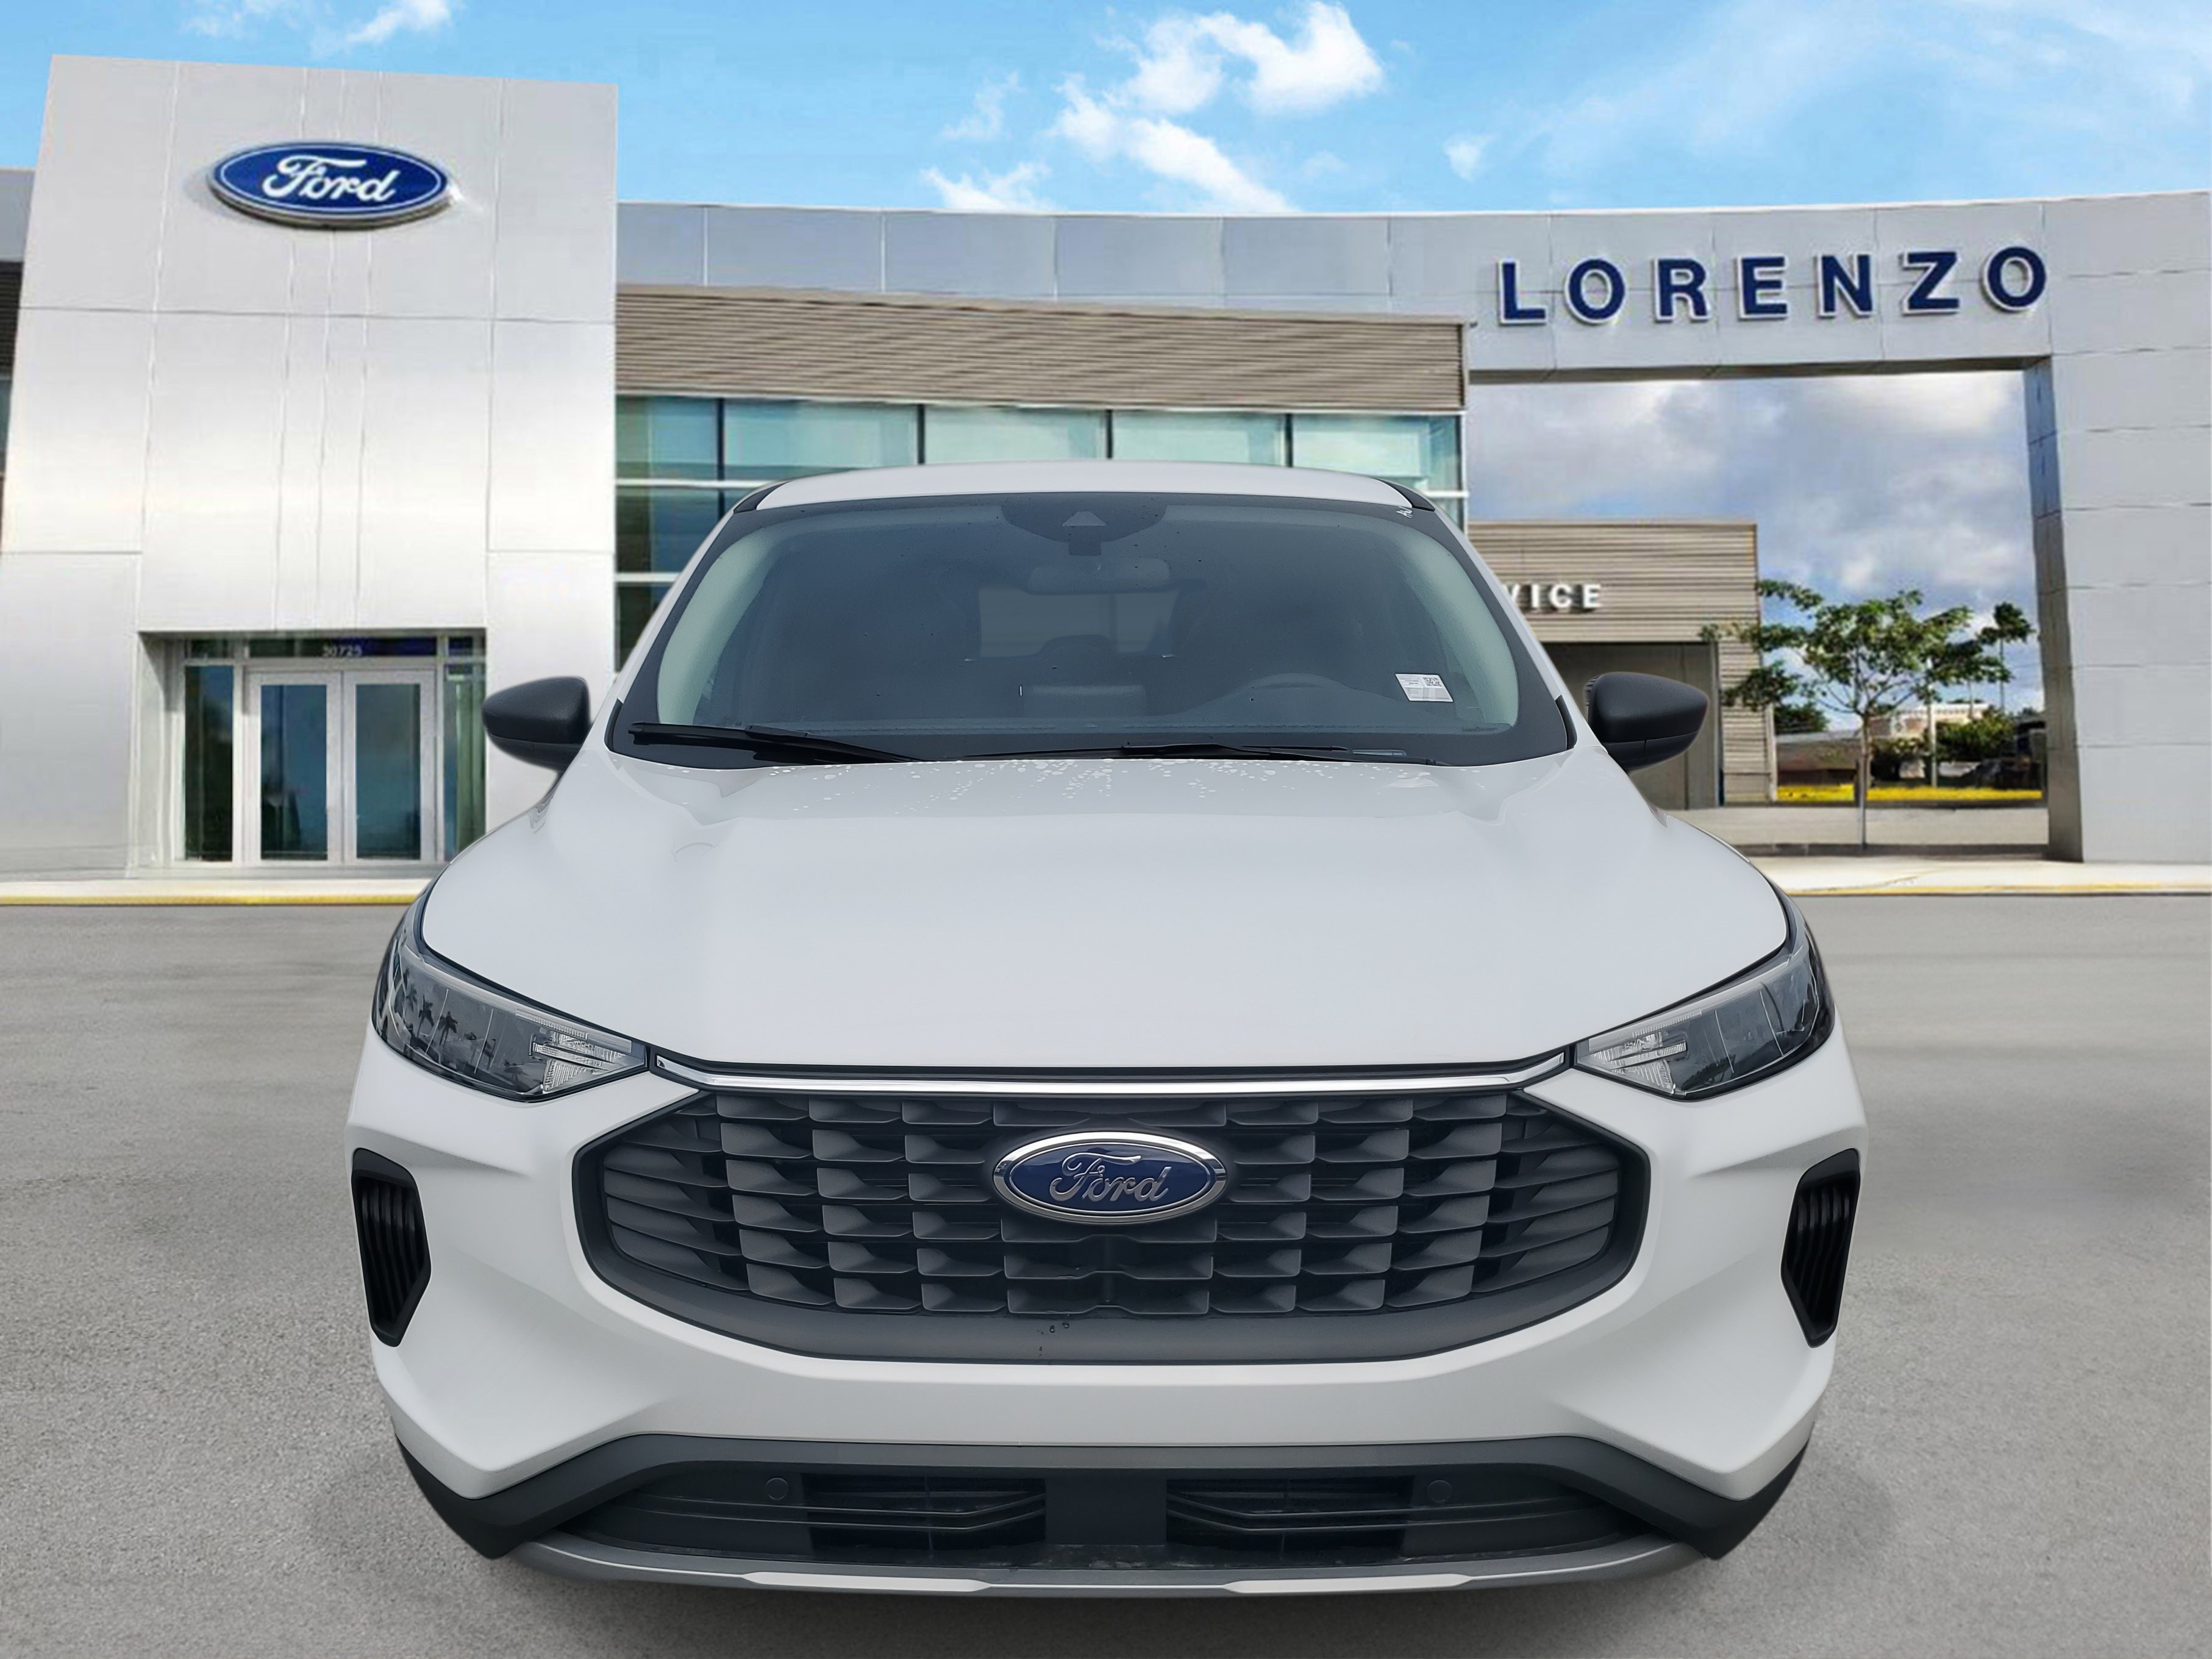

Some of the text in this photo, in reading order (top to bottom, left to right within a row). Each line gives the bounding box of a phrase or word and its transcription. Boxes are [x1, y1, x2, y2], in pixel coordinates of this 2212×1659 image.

[262, 154, 401, 202] Ford
[1498, 246, 2047, 324] LORENZO
[1049, 1152, 1172, 1202] Ford
